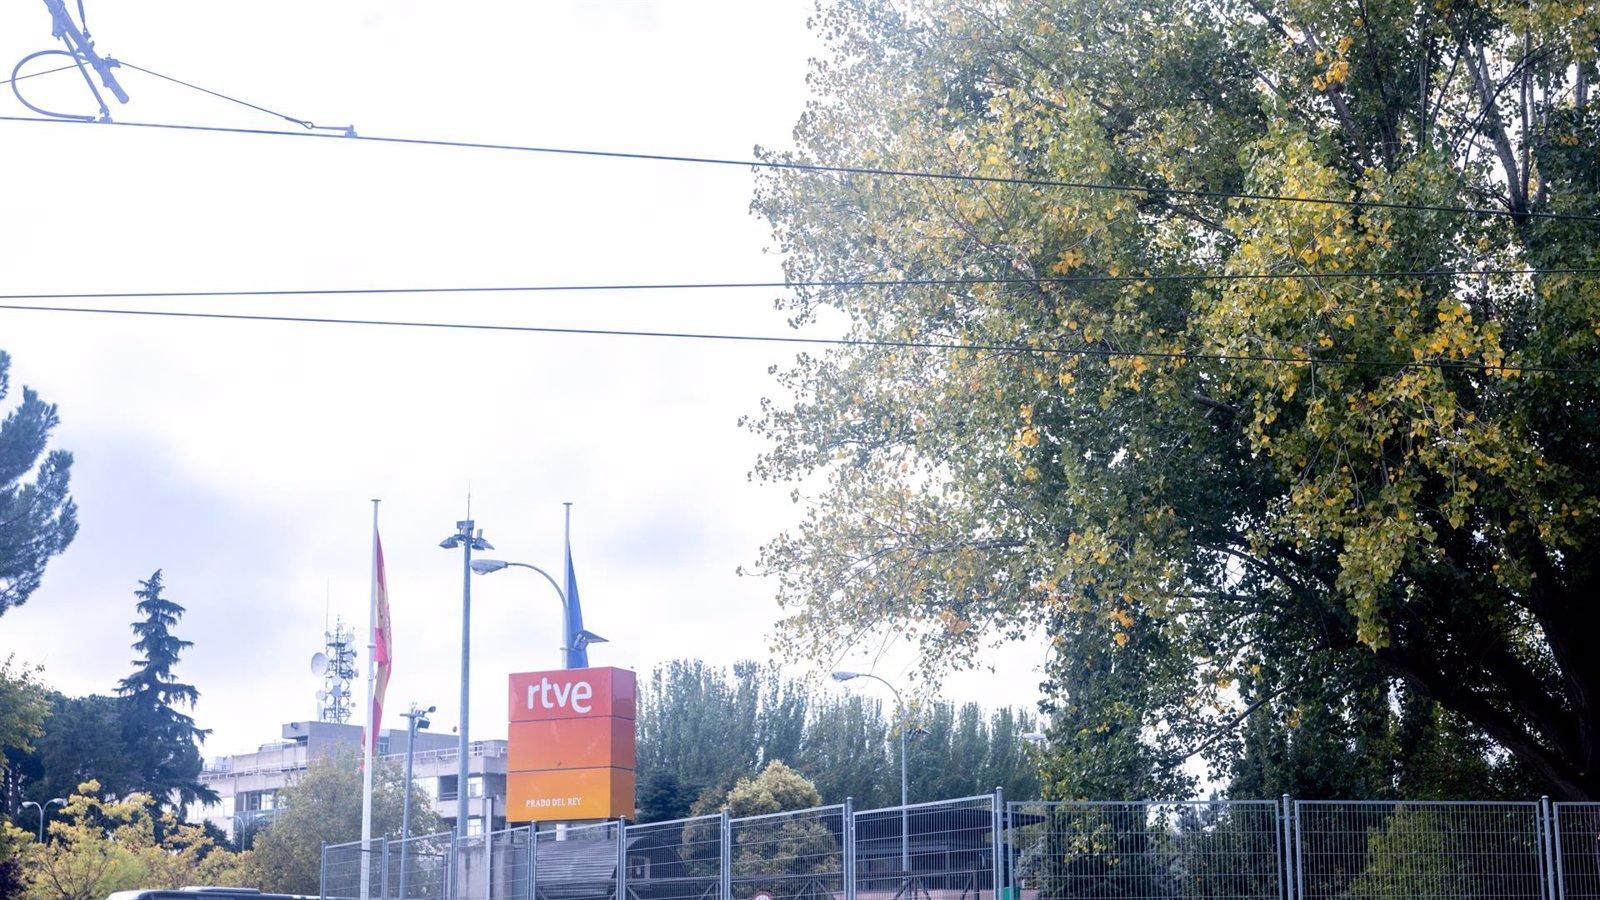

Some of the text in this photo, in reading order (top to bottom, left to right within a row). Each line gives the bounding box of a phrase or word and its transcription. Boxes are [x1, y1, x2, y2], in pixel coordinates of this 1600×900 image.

[528, 677, 592, 713] rtve
[526, 797, 582, 808] PRADO DEL REY
